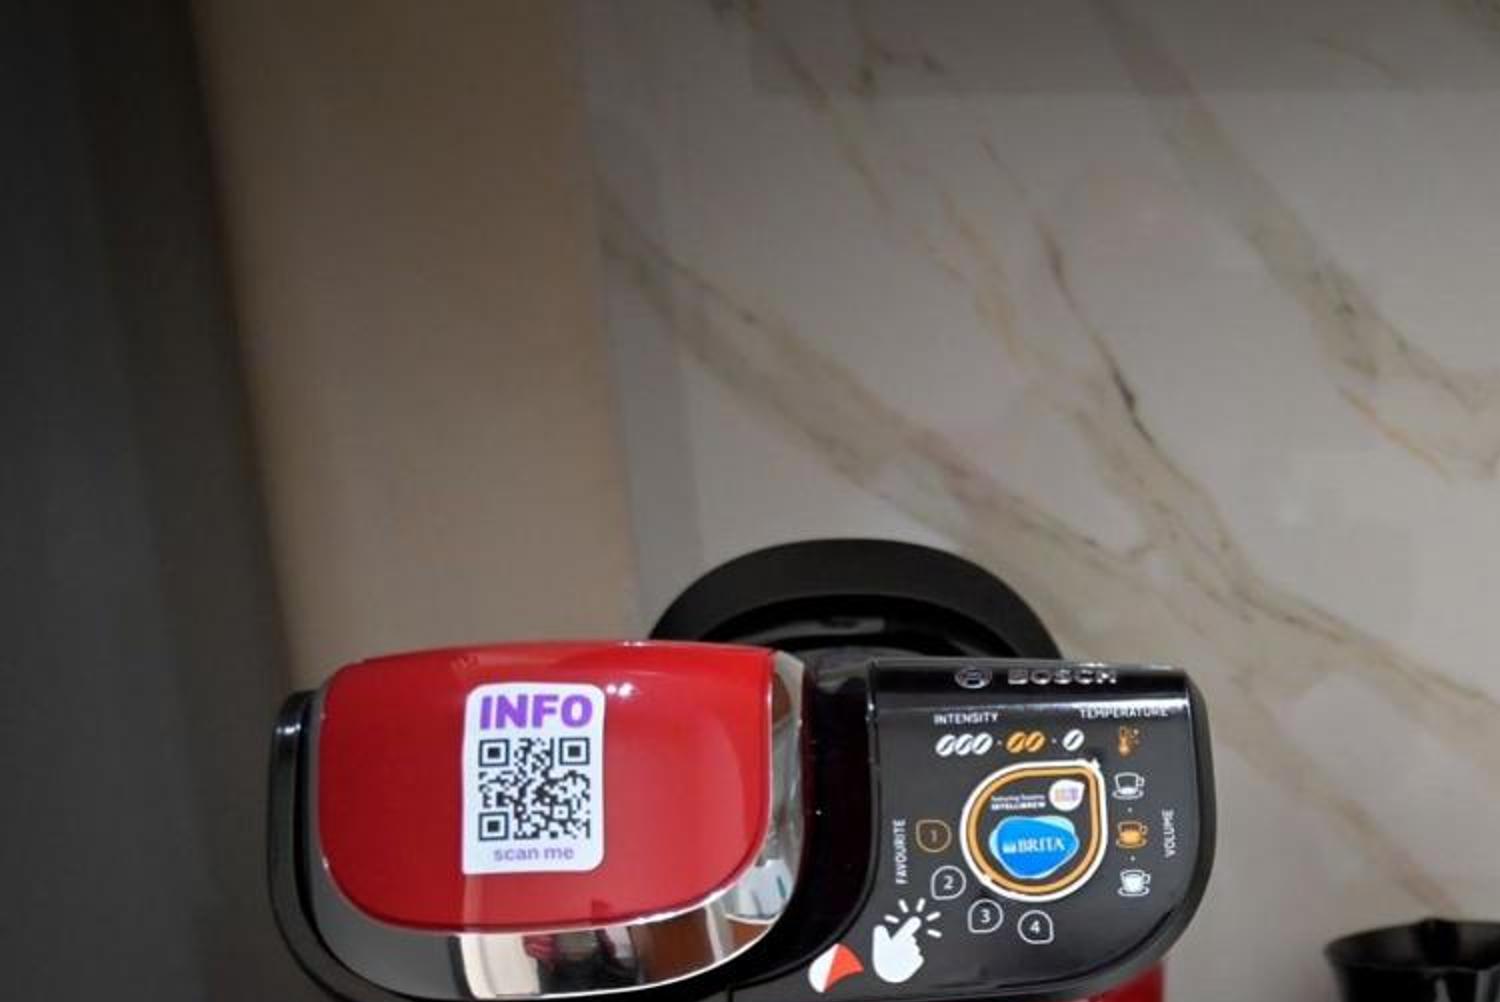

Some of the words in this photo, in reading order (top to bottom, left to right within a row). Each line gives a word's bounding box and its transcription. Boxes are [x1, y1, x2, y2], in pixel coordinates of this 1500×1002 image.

[1007, 668, 1117, 685] BOSCH
[479, 694, 593, 730] INFO
[934, 711, 999, 726] INTENSITY
[1080, 705, 1169, 719] TEMPERATURE
[1162, 809, 1176, 859] VOLUME
[894, 819, 907, 885] FAVOURITE
[1017, 836, 1066, 853] BRITA
[493, 846, 539, 862] scan
[543, 846, 575, 861] me
[943, 876, 954, 890] 2
[980, 908, 991, 924] 3
[1029, 919, 1041, 934] 4
